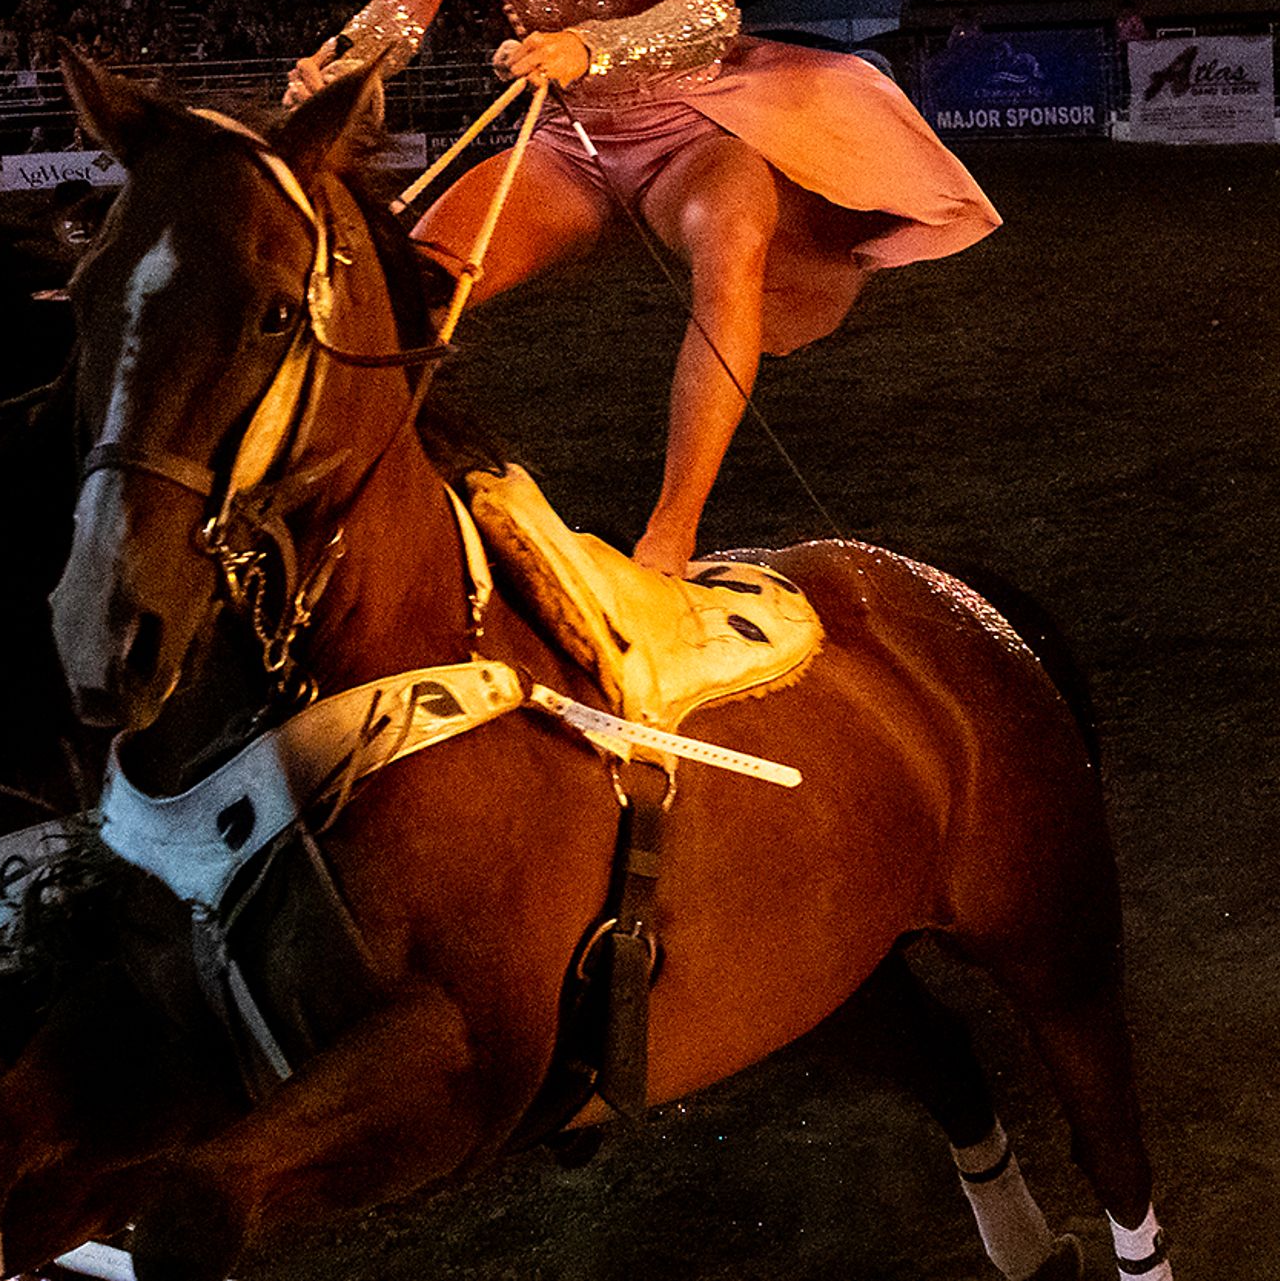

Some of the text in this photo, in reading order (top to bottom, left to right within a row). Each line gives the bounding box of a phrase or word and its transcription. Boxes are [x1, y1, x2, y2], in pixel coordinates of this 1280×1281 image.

[1144, 45, 1248, 102] Atlas
[937, 104, 1096, 129] MAJOR SPONSOR
[20, 165, 91, 187] AgWest
